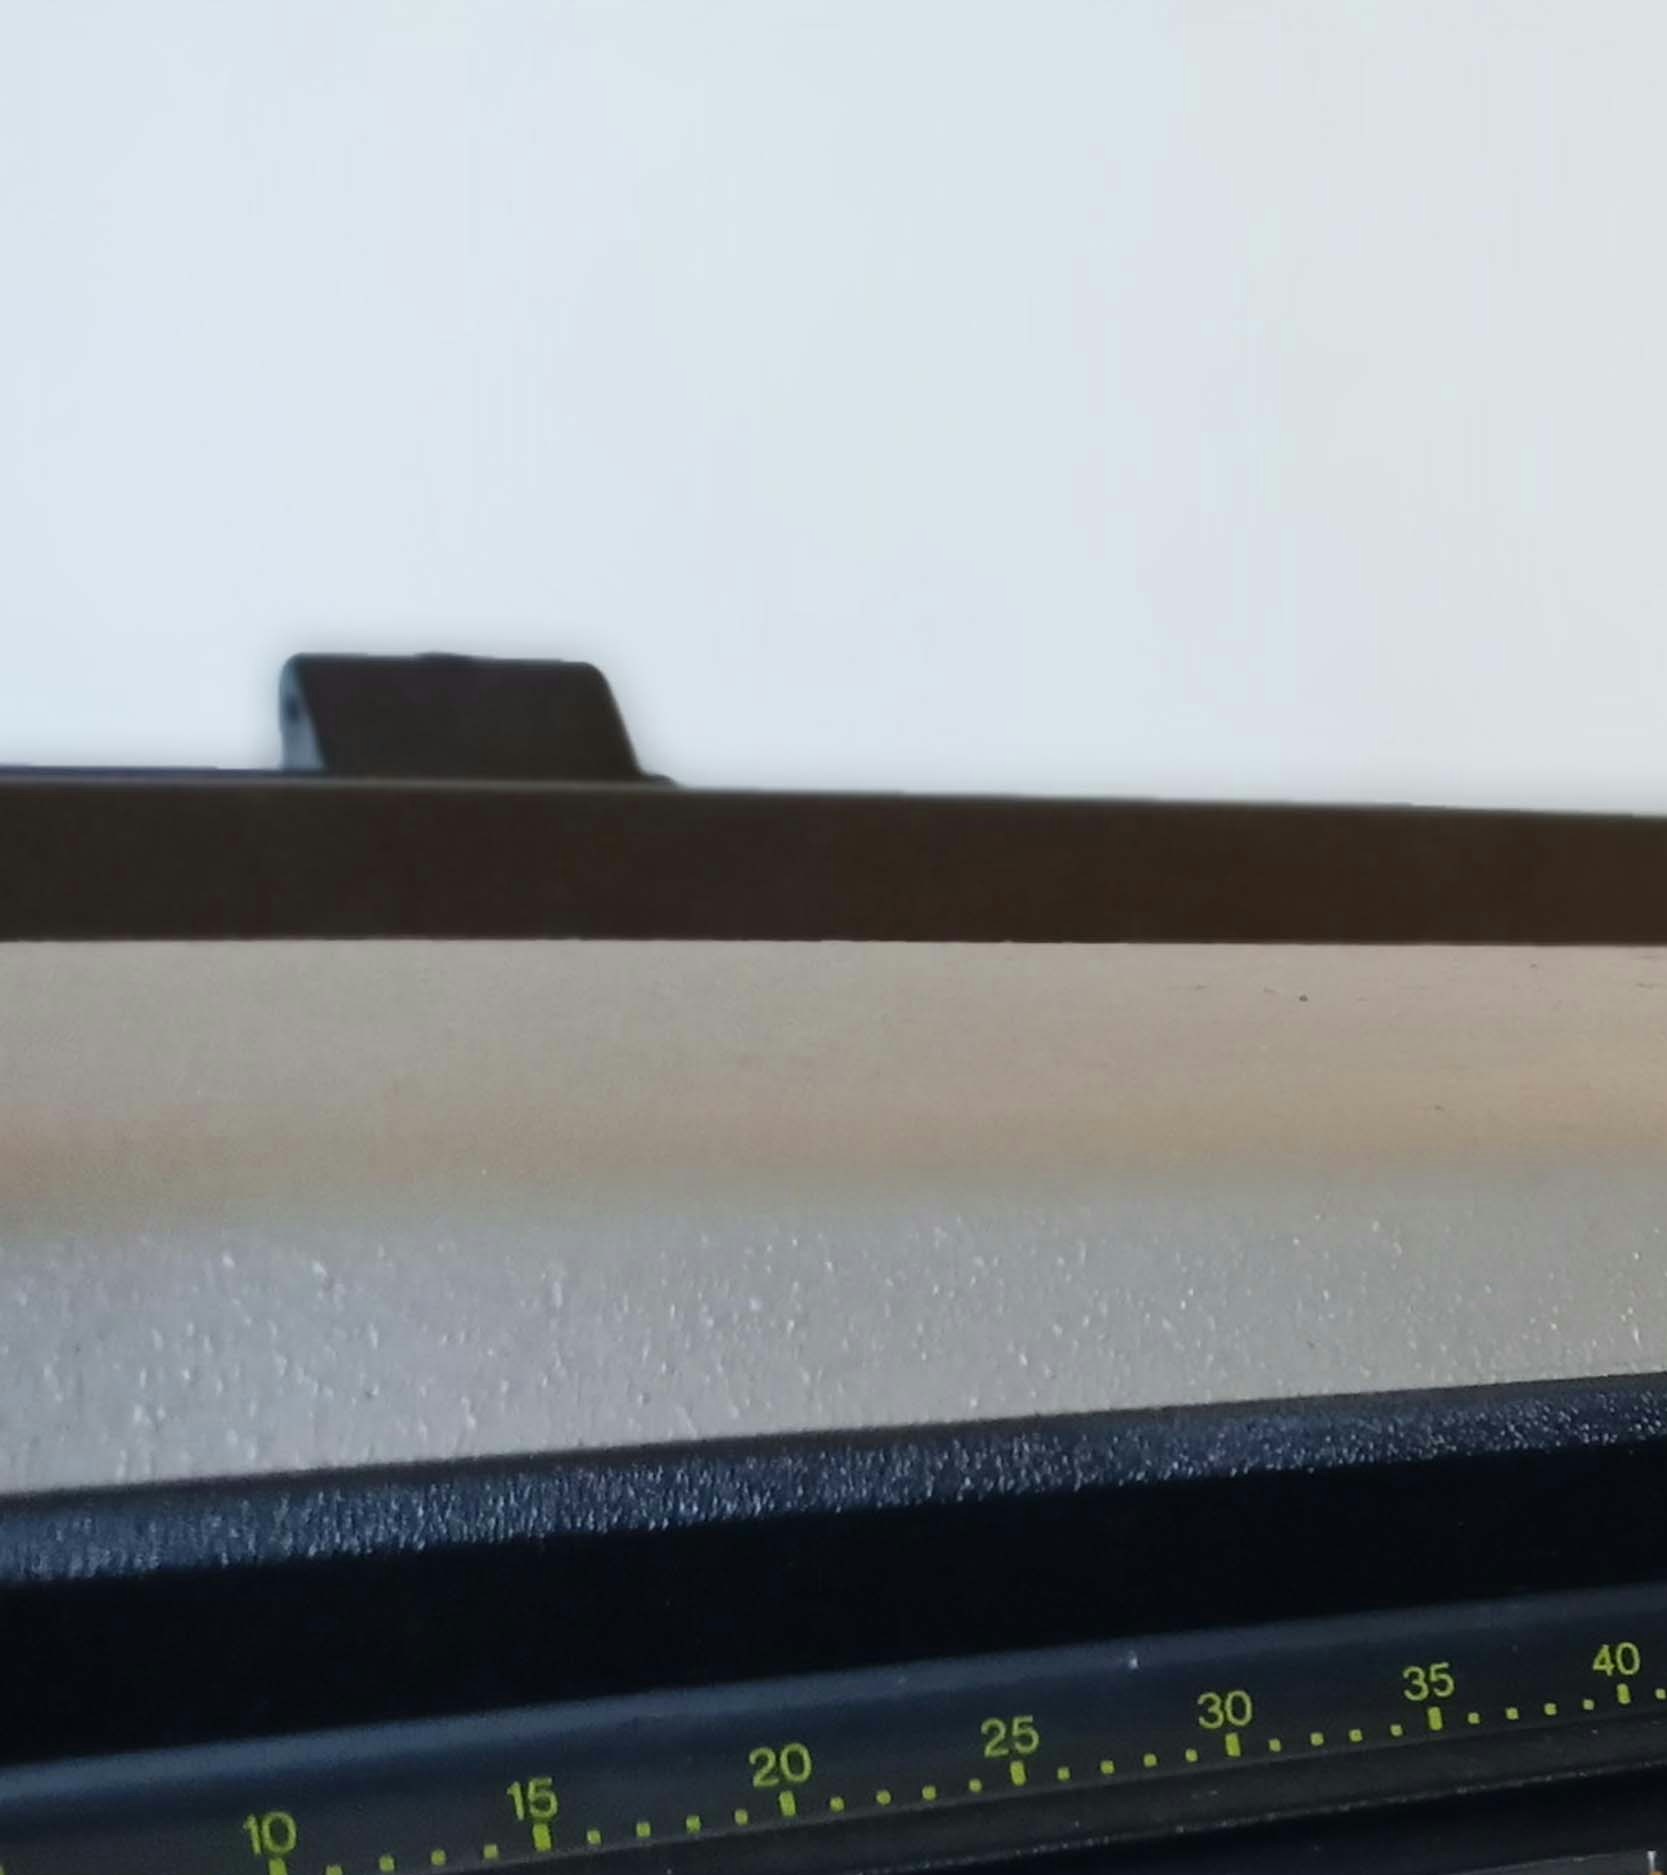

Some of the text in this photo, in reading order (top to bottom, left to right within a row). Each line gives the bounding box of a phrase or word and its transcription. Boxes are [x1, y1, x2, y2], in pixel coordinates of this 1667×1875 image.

[243, 1811, 298, 1857] 10
[506, 1777, 560, 1821] 15
[750, 1743, 814, 1789] 20
[982, 1716, 1041, 1759] 25
[1200, 1690, 1254, 1731] 30
[1403, 1663, 1456, 1702] 35
[1594, 1642, 1640, 1676] 40
